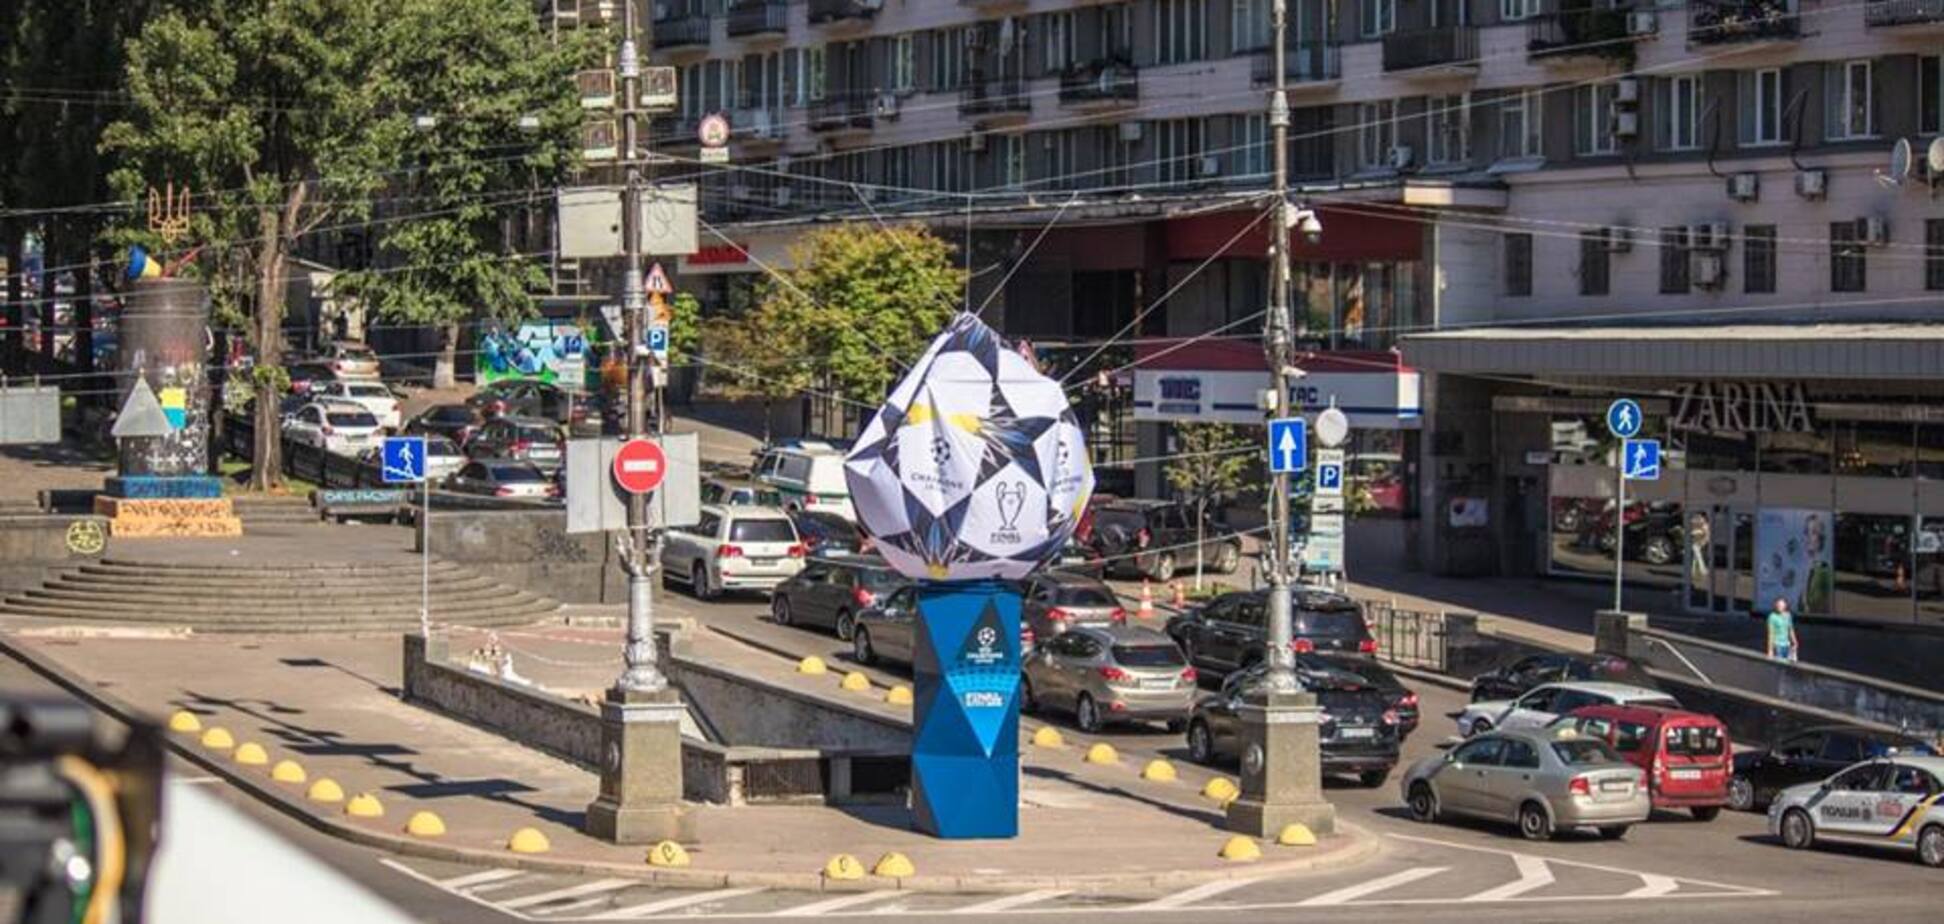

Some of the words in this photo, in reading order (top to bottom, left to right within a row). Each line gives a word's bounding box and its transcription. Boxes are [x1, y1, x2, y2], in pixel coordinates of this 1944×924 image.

[651, 332, 663, 347] P
[1673, 381, 1815, 432] ZARINA
[1324, 467, 1337, 486] P
